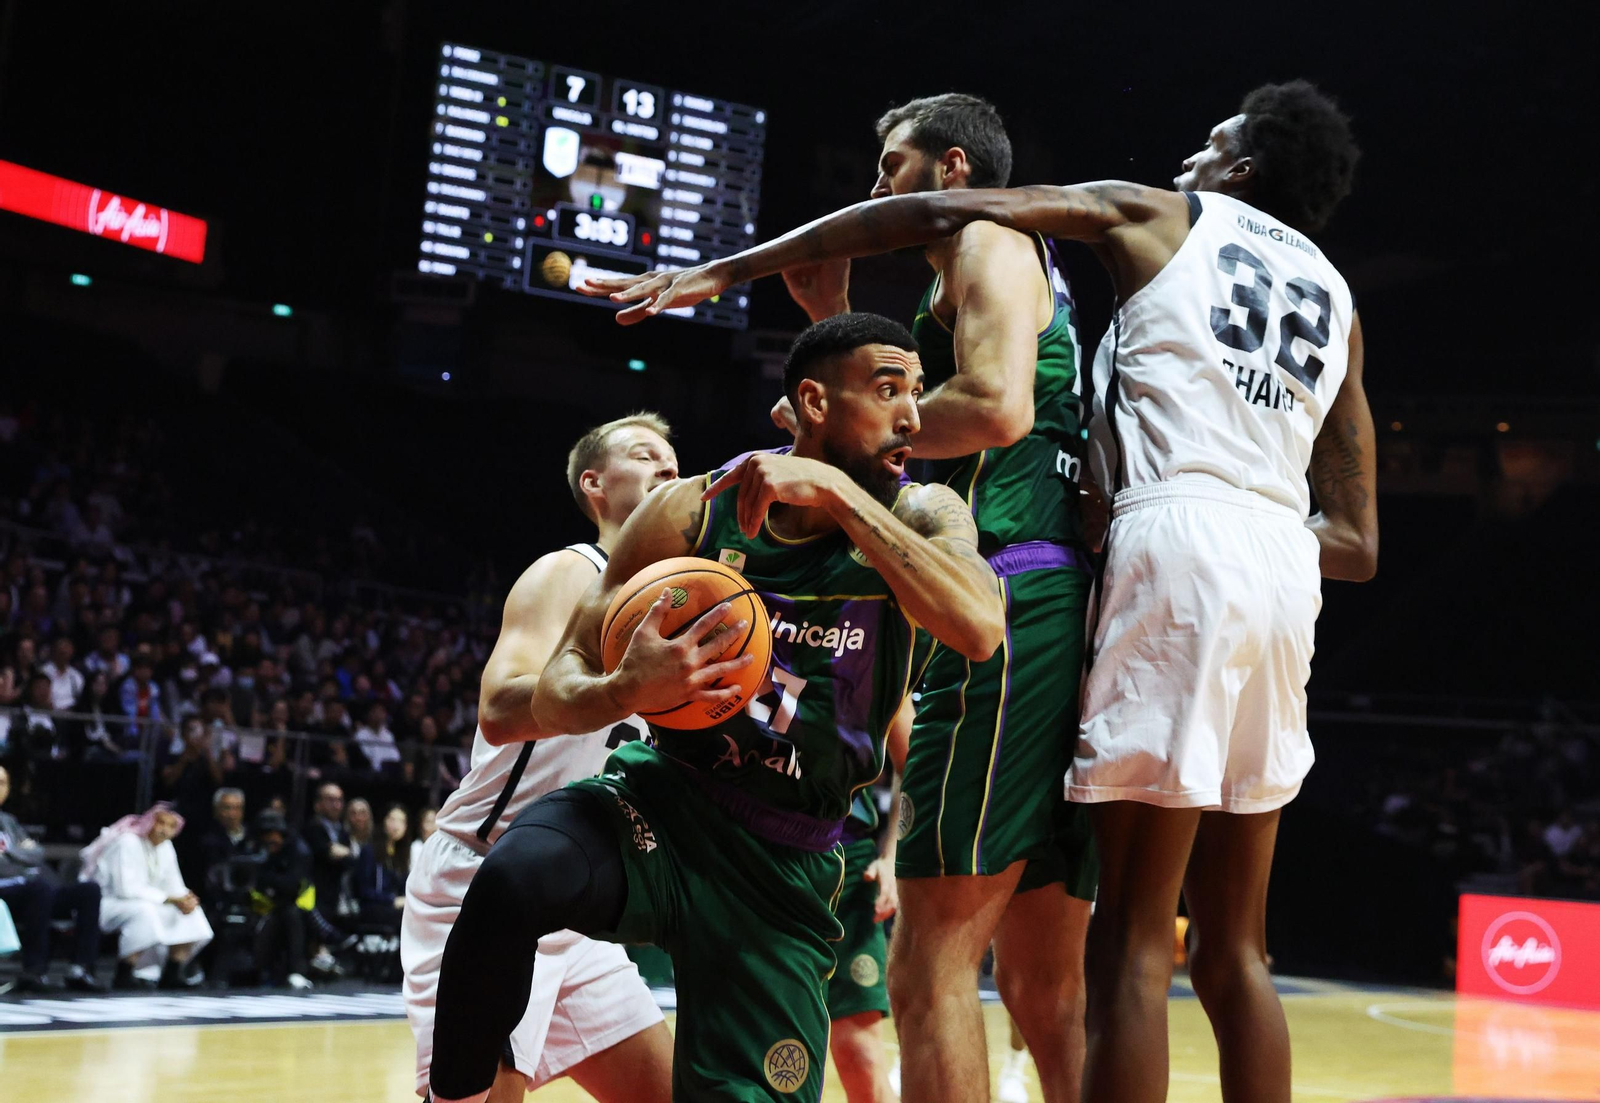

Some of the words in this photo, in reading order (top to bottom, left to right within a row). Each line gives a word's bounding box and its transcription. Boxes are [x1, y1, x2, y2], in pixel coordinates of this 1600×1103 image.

[566, 75, 586, 103] 7
[622, 88, 655, 119] 13
[1246, 218, 1268, 238] NBA
[1210, 242, 1332, 395] 32
[709, 694, 743, 720] FIBA
